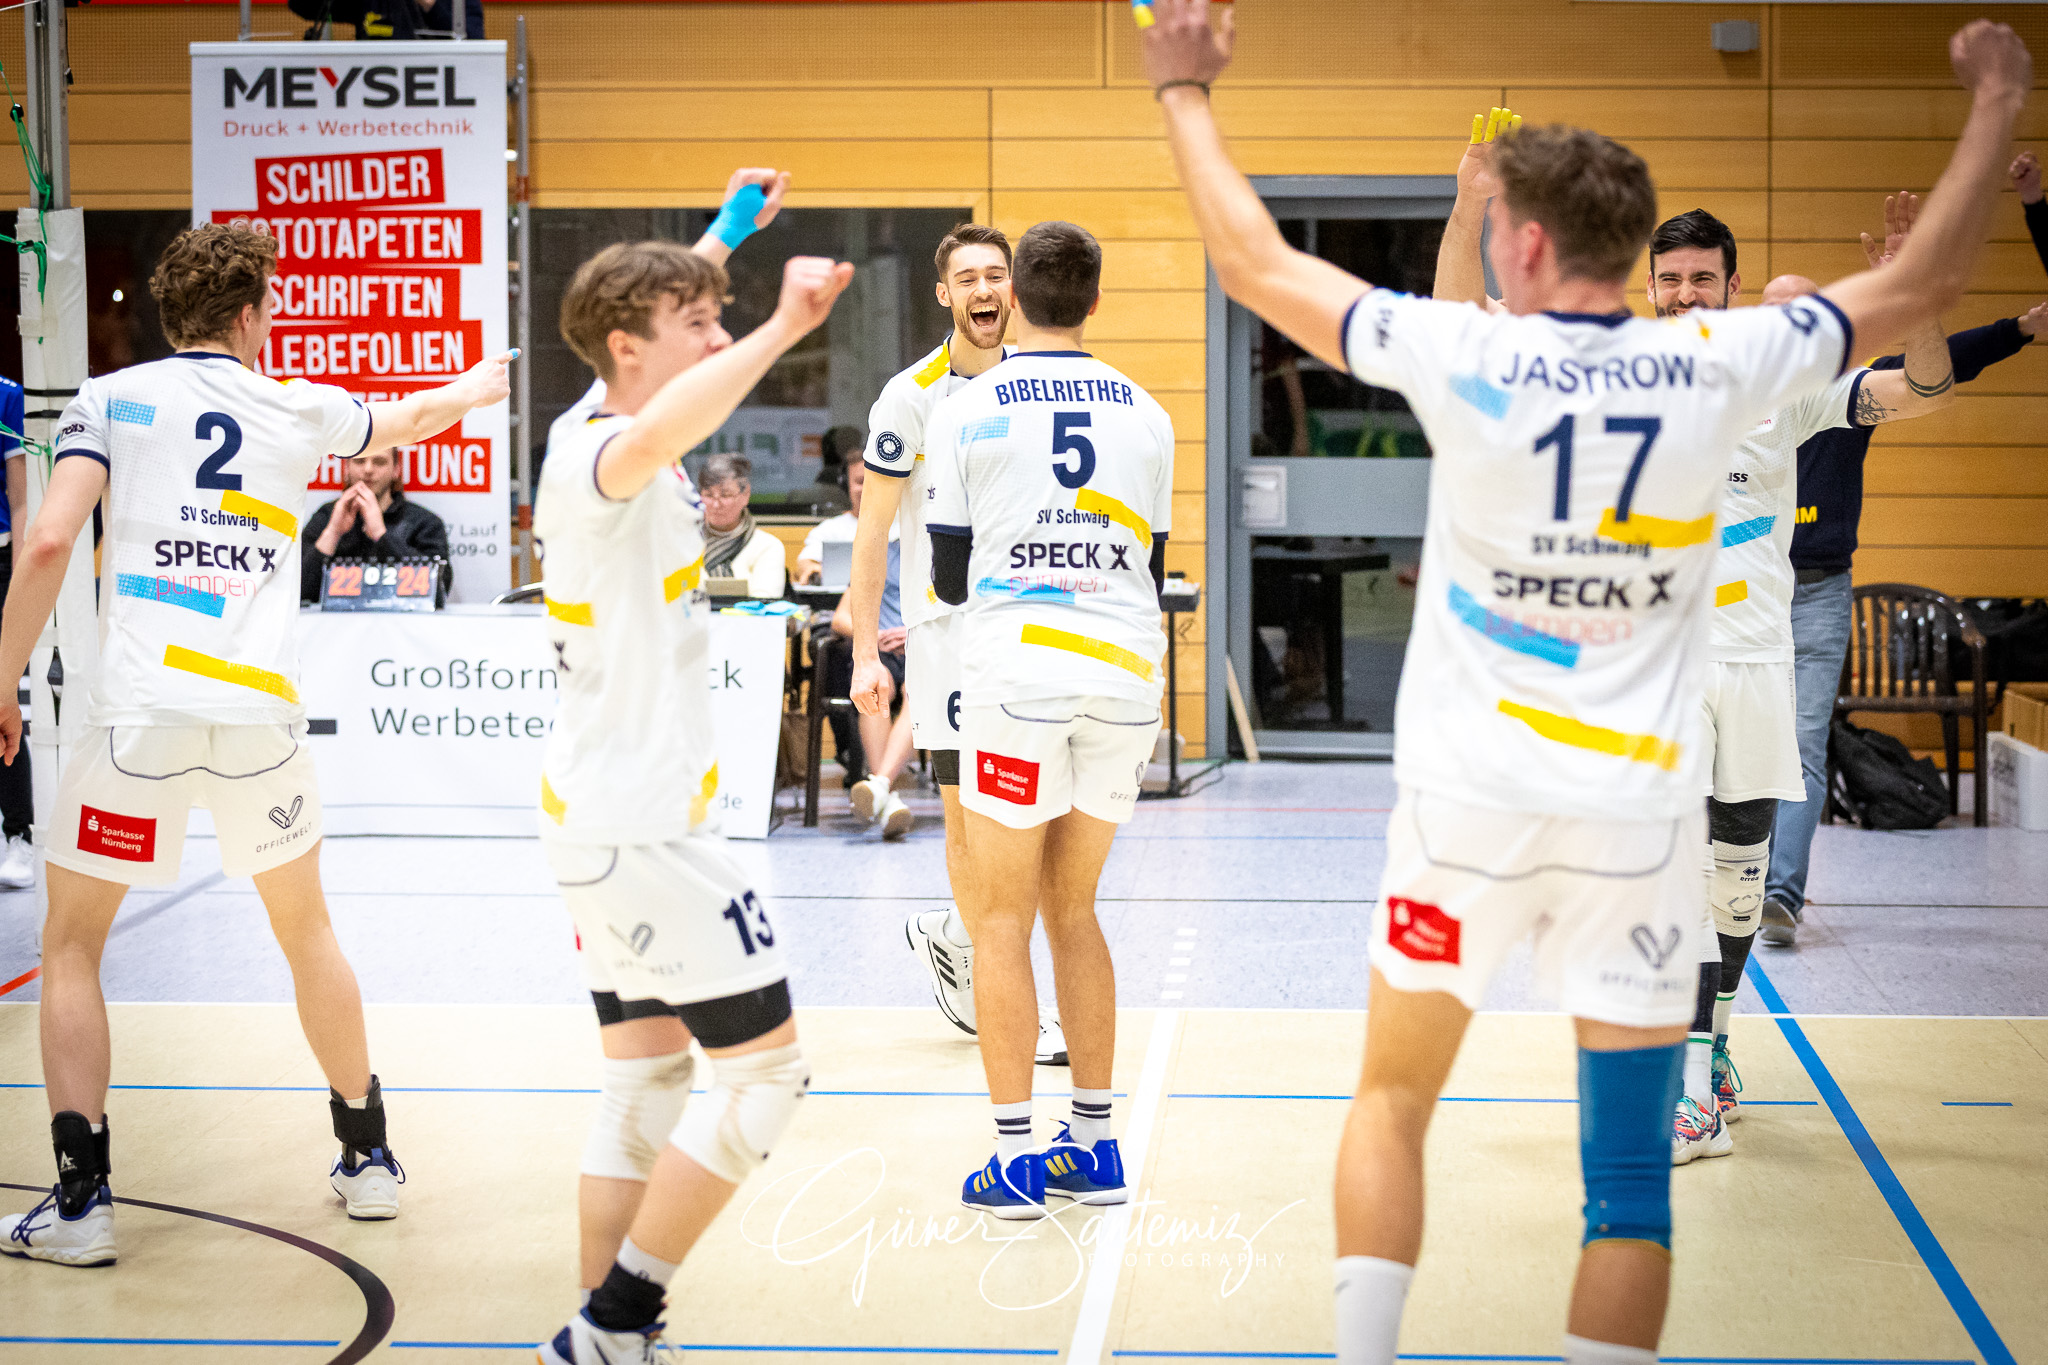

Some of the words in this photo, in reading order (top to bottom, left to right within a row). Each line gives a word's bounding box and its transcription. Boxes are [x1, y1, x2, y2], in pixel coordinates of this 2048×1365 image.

[223, 66, 477, 108] MEYSEL
[223, 119, 289, 137] Druck
[317, 118, 474, 137] Werbetechnik
[265, 155, 432, 205] SCHILDER
[254, 330, 465, 377] LEBEFOLIEN
[1500, 352, 1696, 395] JASTROW
[994, 378, 1134, 406] BIBELRIETHER
[195, 411, 243, 491] 2
[1052, 411, 1096, 489] 5
[1531, 413, 1663, 523] 17
[180, 505, 197, 522] SV
[201, 508, 259, 532] Schwaig
[460, 523, 497, 537] Lauf
[1037, 508, 1052, 524] SV
[1056, 508, 1110, 529] Schwaig
[155, 539, 251, 573] SPECK
[1010, 542, 1102, 569] SPECK
[156, 574, 257, 602] pumpen
[328, 566, 362, 596] 22
[397, 566, 430, 596] 24
[1010, 573, 1108, 597] pumpen
[1491, 569, 1632, 609] SPECK
[101, 825, 146, 841] Sparkasse
[101, 836, 142, 853] Nürnberg
[255, 822, 312, 853] OFFICEWELT
[722, 889, 775, 957] 13
